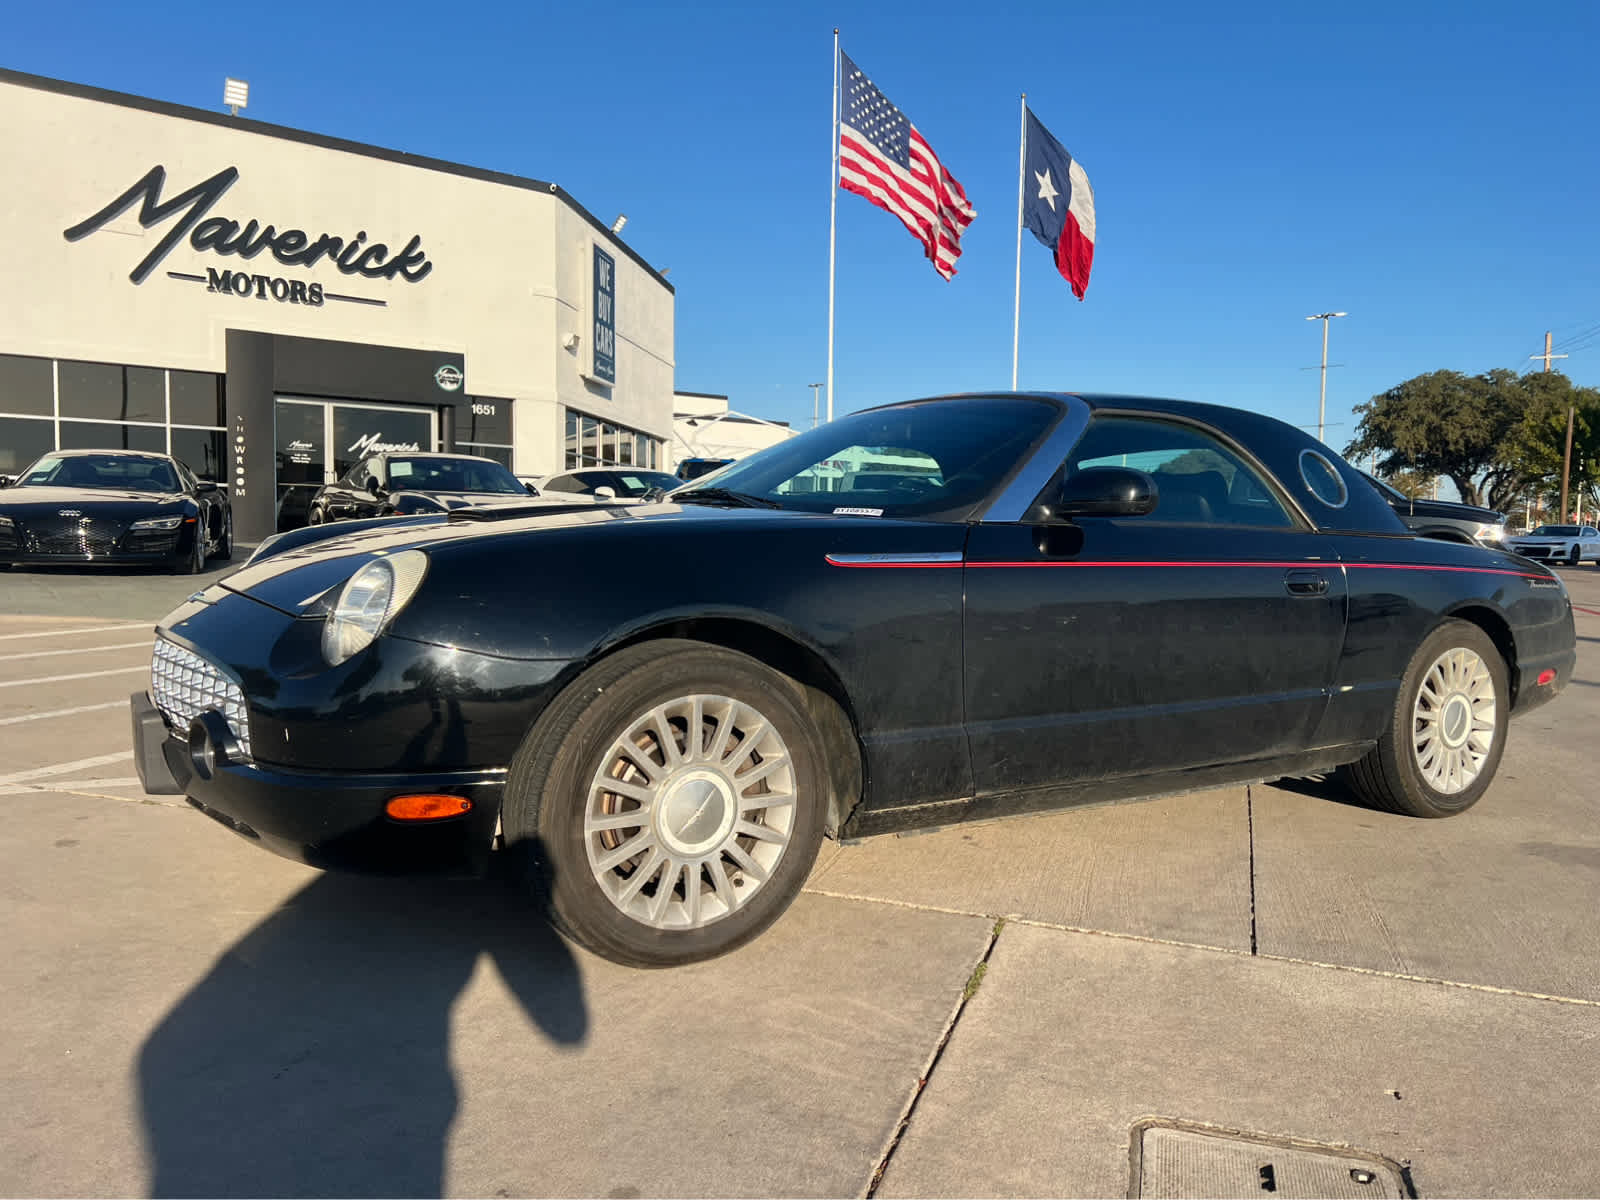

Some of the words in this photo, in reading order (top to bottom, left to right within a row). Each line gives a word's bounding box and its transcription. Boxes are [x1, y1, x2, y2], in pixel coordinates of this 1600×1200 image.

[63, 164, 432, 285] Maverick
[206, 267, 324, 306] MOTORS
[599, 256, 611, 292] WE
[598, 289, 612, 325] BUY
[595, 321, 613, 358] CARS
[472, 403, 496, 416] 1651
